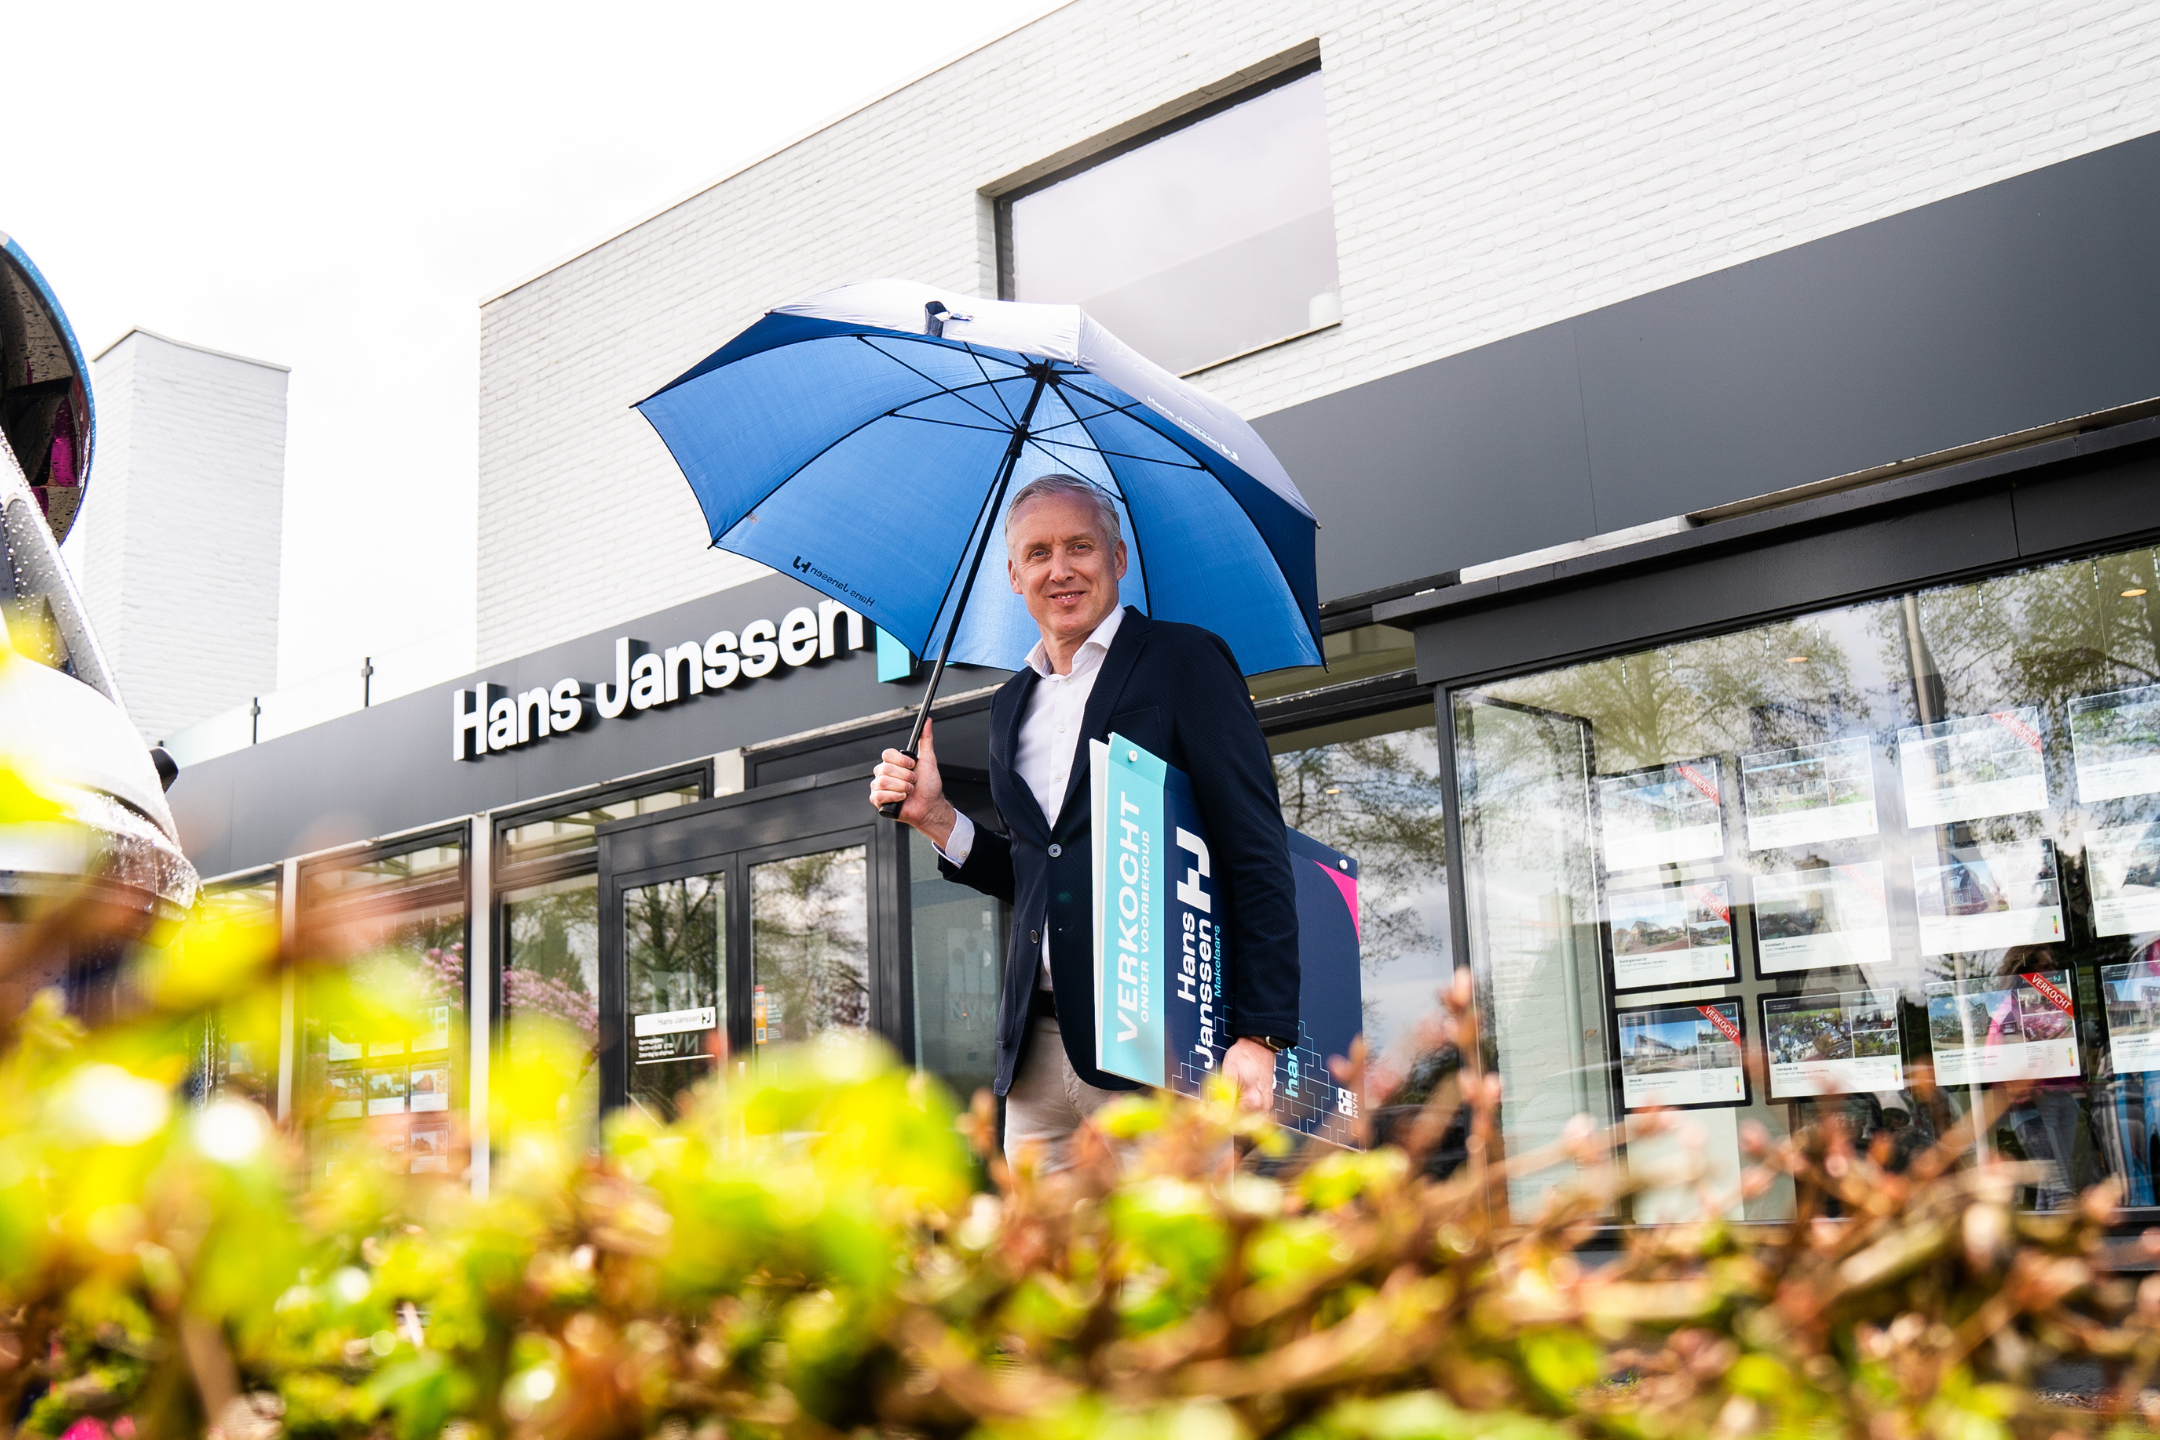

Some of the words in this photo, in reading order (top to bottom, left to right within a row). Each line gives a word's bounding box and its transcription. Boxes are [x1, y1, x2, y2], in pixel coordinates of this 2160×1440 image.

[453, 677, 582, 762] Hans
[595, 598, 864, 719] Janssen
[1685, 767, 1716, 798] VERKOCHT
[1116, 789, 1140, 1043] VERKOCHT
[1140, 830, 1150, 954] VOORBEHOUD
[1140, 960, 1150, 1024] ONDER
[1177, 911, 1196, 1003] Hans
[1195, 918, 1214, 1070] Janssen
[1213, 925, 1222, 998] Makelaars
[2032, 974, 2072, 1010] VERKOCHT
[1705, 1006, 1739, 1039] VERKOCHT
